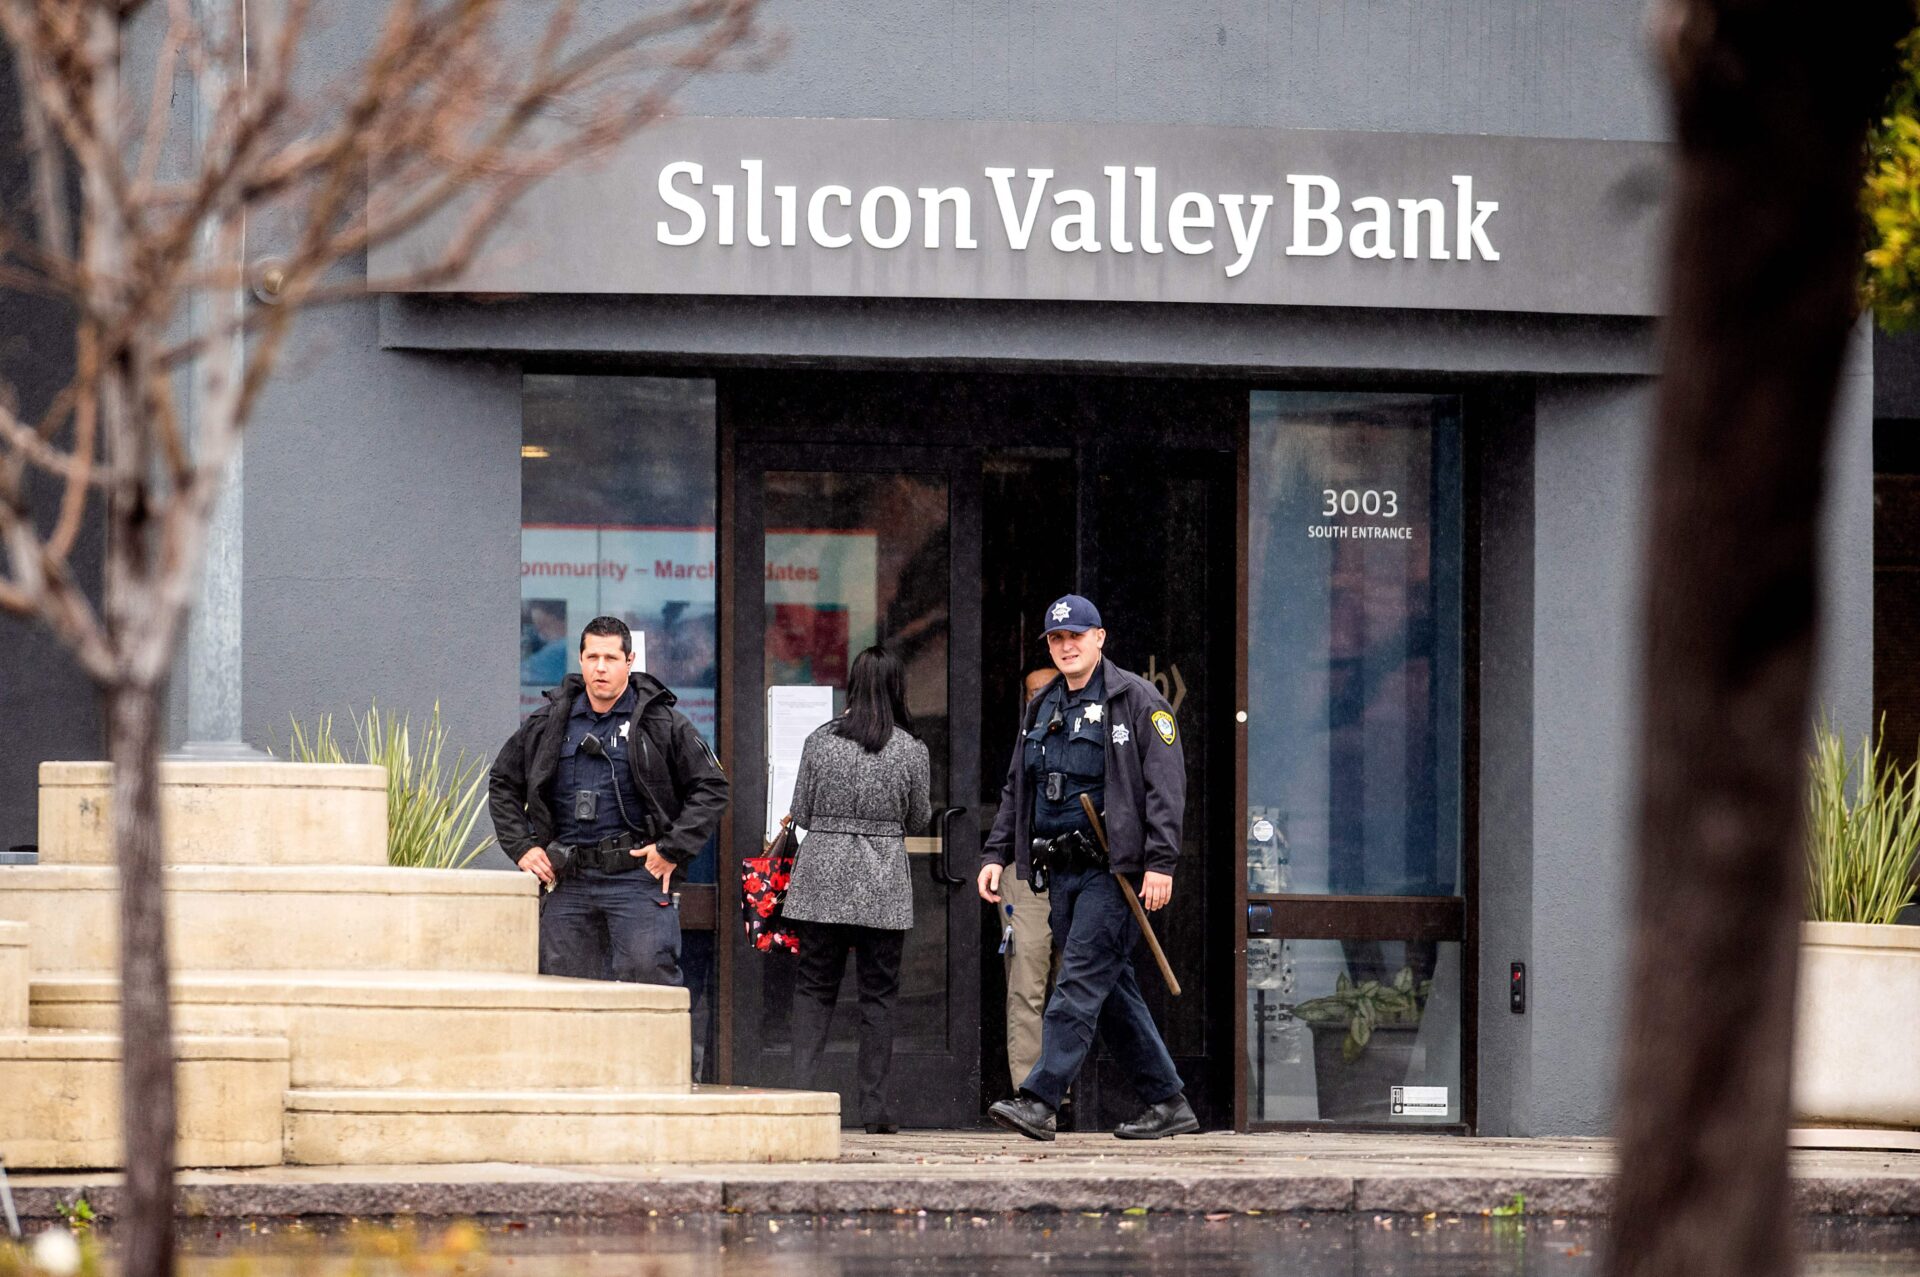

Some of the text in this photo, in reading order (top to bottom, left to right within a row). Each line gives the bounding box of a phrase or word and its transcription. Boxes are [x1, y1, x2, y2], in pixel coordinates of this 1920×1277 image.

[657, 160, 1500, 278] Silicon Valley Bank
[1322, 488, 1398, 517] 3003
[1307, 525, 1413, 539] SOUTH ENTRANCE
